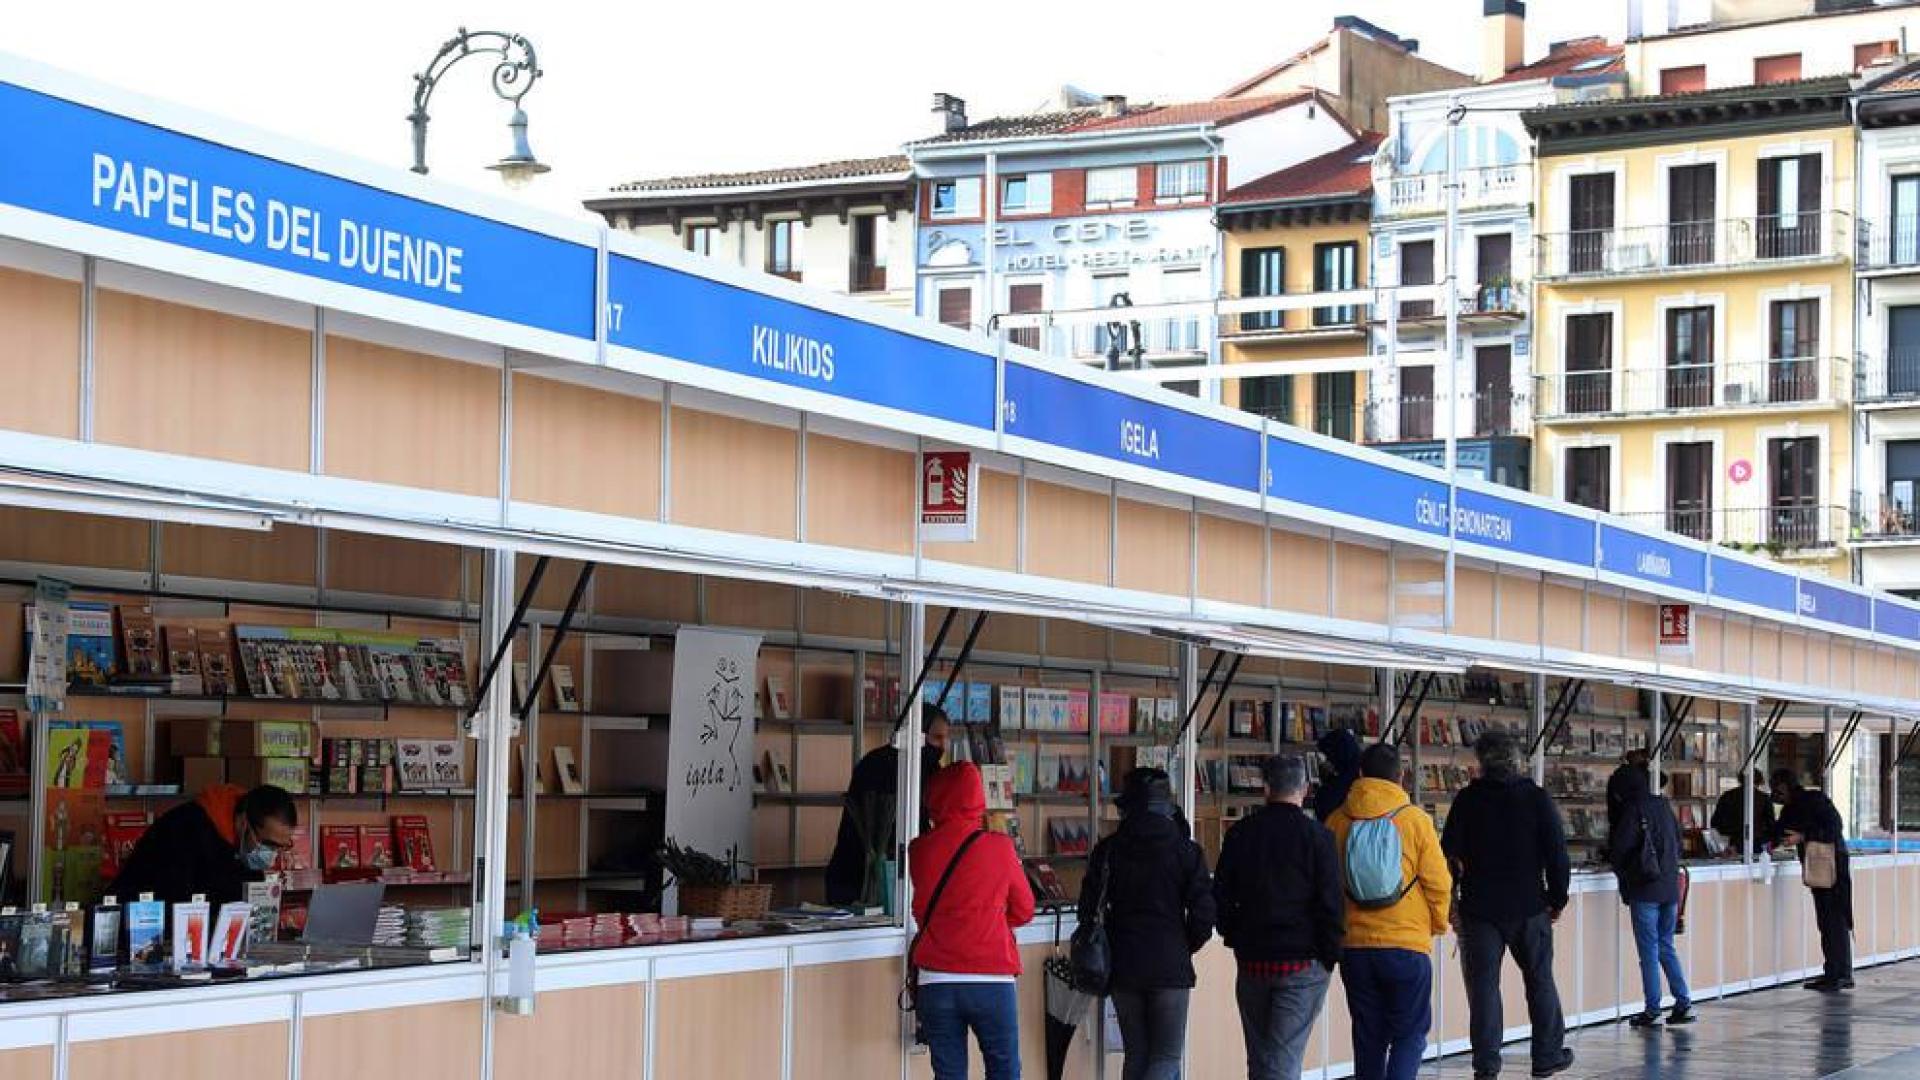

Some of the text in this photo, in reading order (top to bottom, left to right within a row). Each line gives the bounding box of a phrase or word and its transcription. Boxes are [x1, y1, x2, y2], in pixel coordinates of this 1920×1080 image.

[92, 153, 464, 294] PAPELES DEL DUENDE
[1008, 254, 1069, 273] HOTEL
[752, 324, 835, 382] KILIKIDS
[1120, 418, 1160, 459] IGELA
[686, 759, 725, 800] igela
